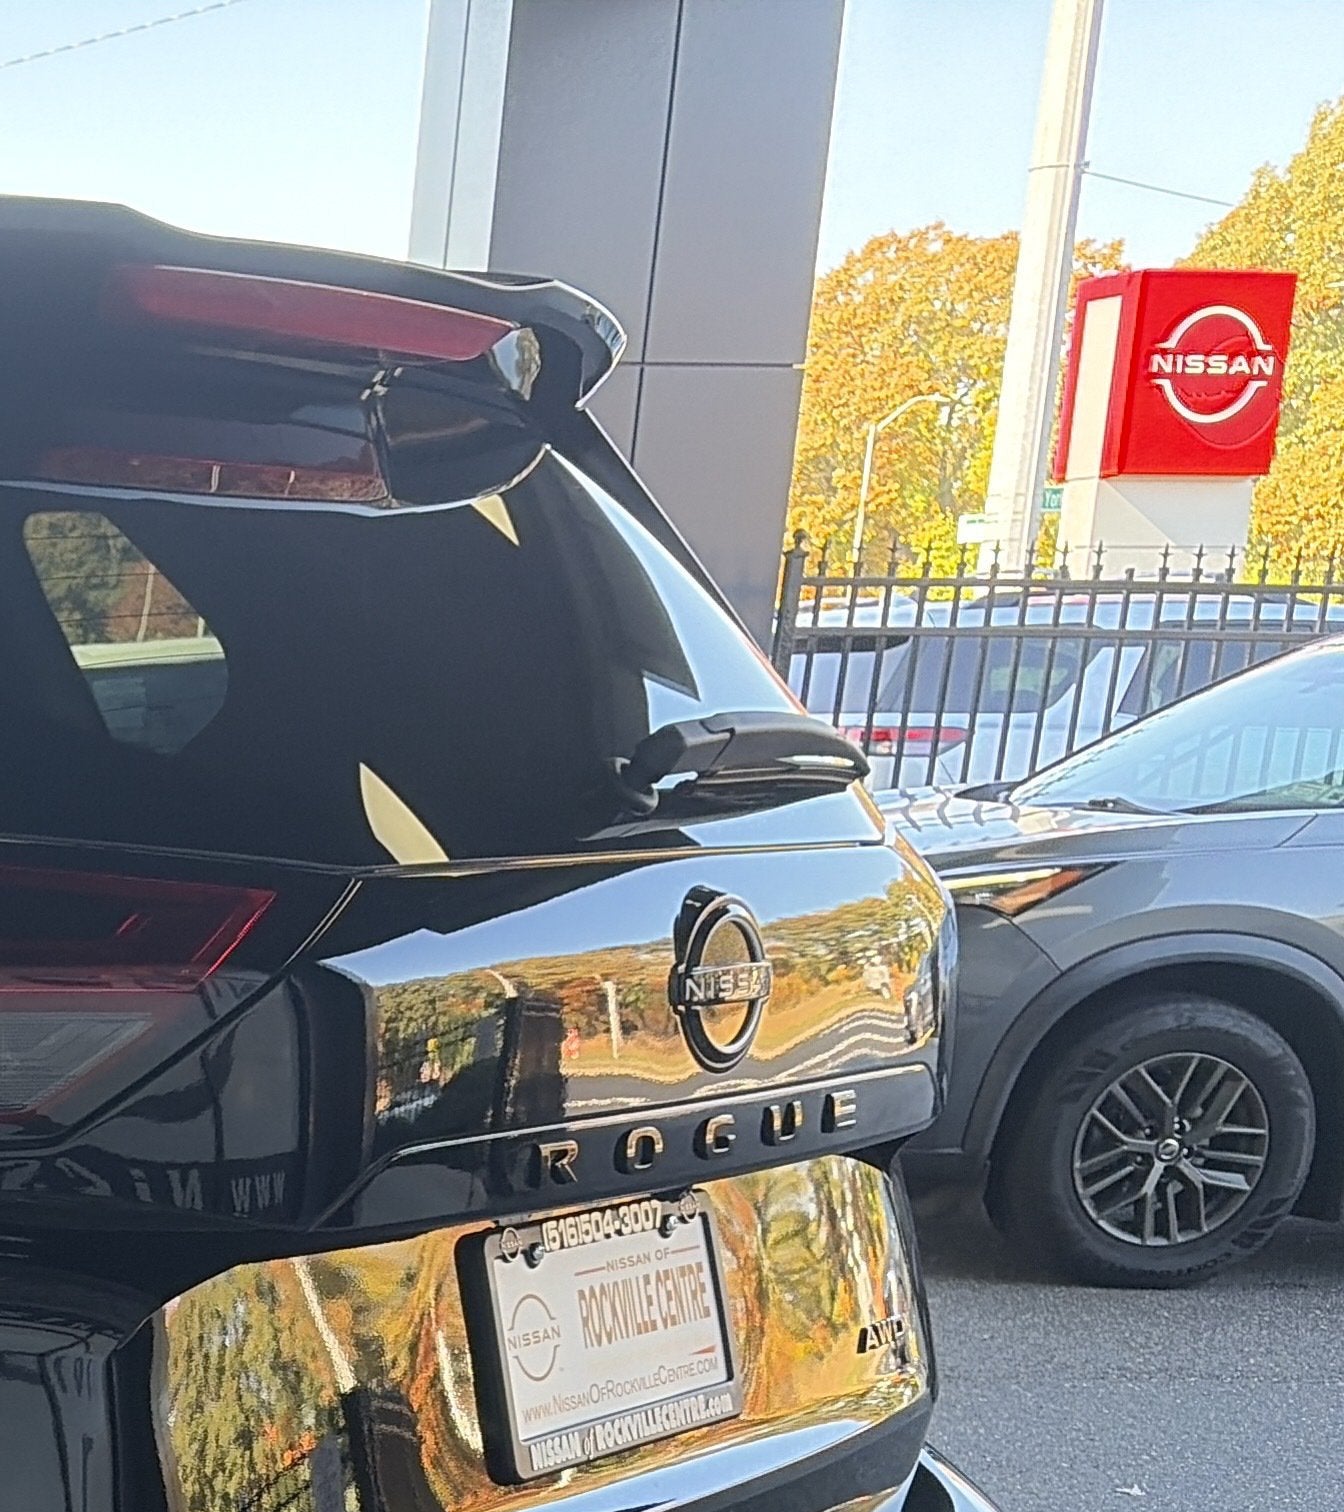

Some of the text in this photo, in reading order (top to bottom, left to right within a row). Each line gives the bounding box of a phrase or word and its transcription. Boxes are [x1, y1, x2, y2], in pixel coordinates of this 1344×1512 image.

[1151, 353, 1275, 376] NISSAN
[537, 1089, 858, 1183] ROGUE
[541, 1199, 662, 1251] (516)504-3007
[605, 1247, 671, 1273] NISSAN OF
[577, 1261, 711, 1349] ROCKVILLE CENTRE
[507, 1325, 561, 1351] NISSAN
[857, 1315, 906, 1354] AWD
[530, 1431, 582, 1471] NISSAN
[583, 1427, 595, 1460] of
